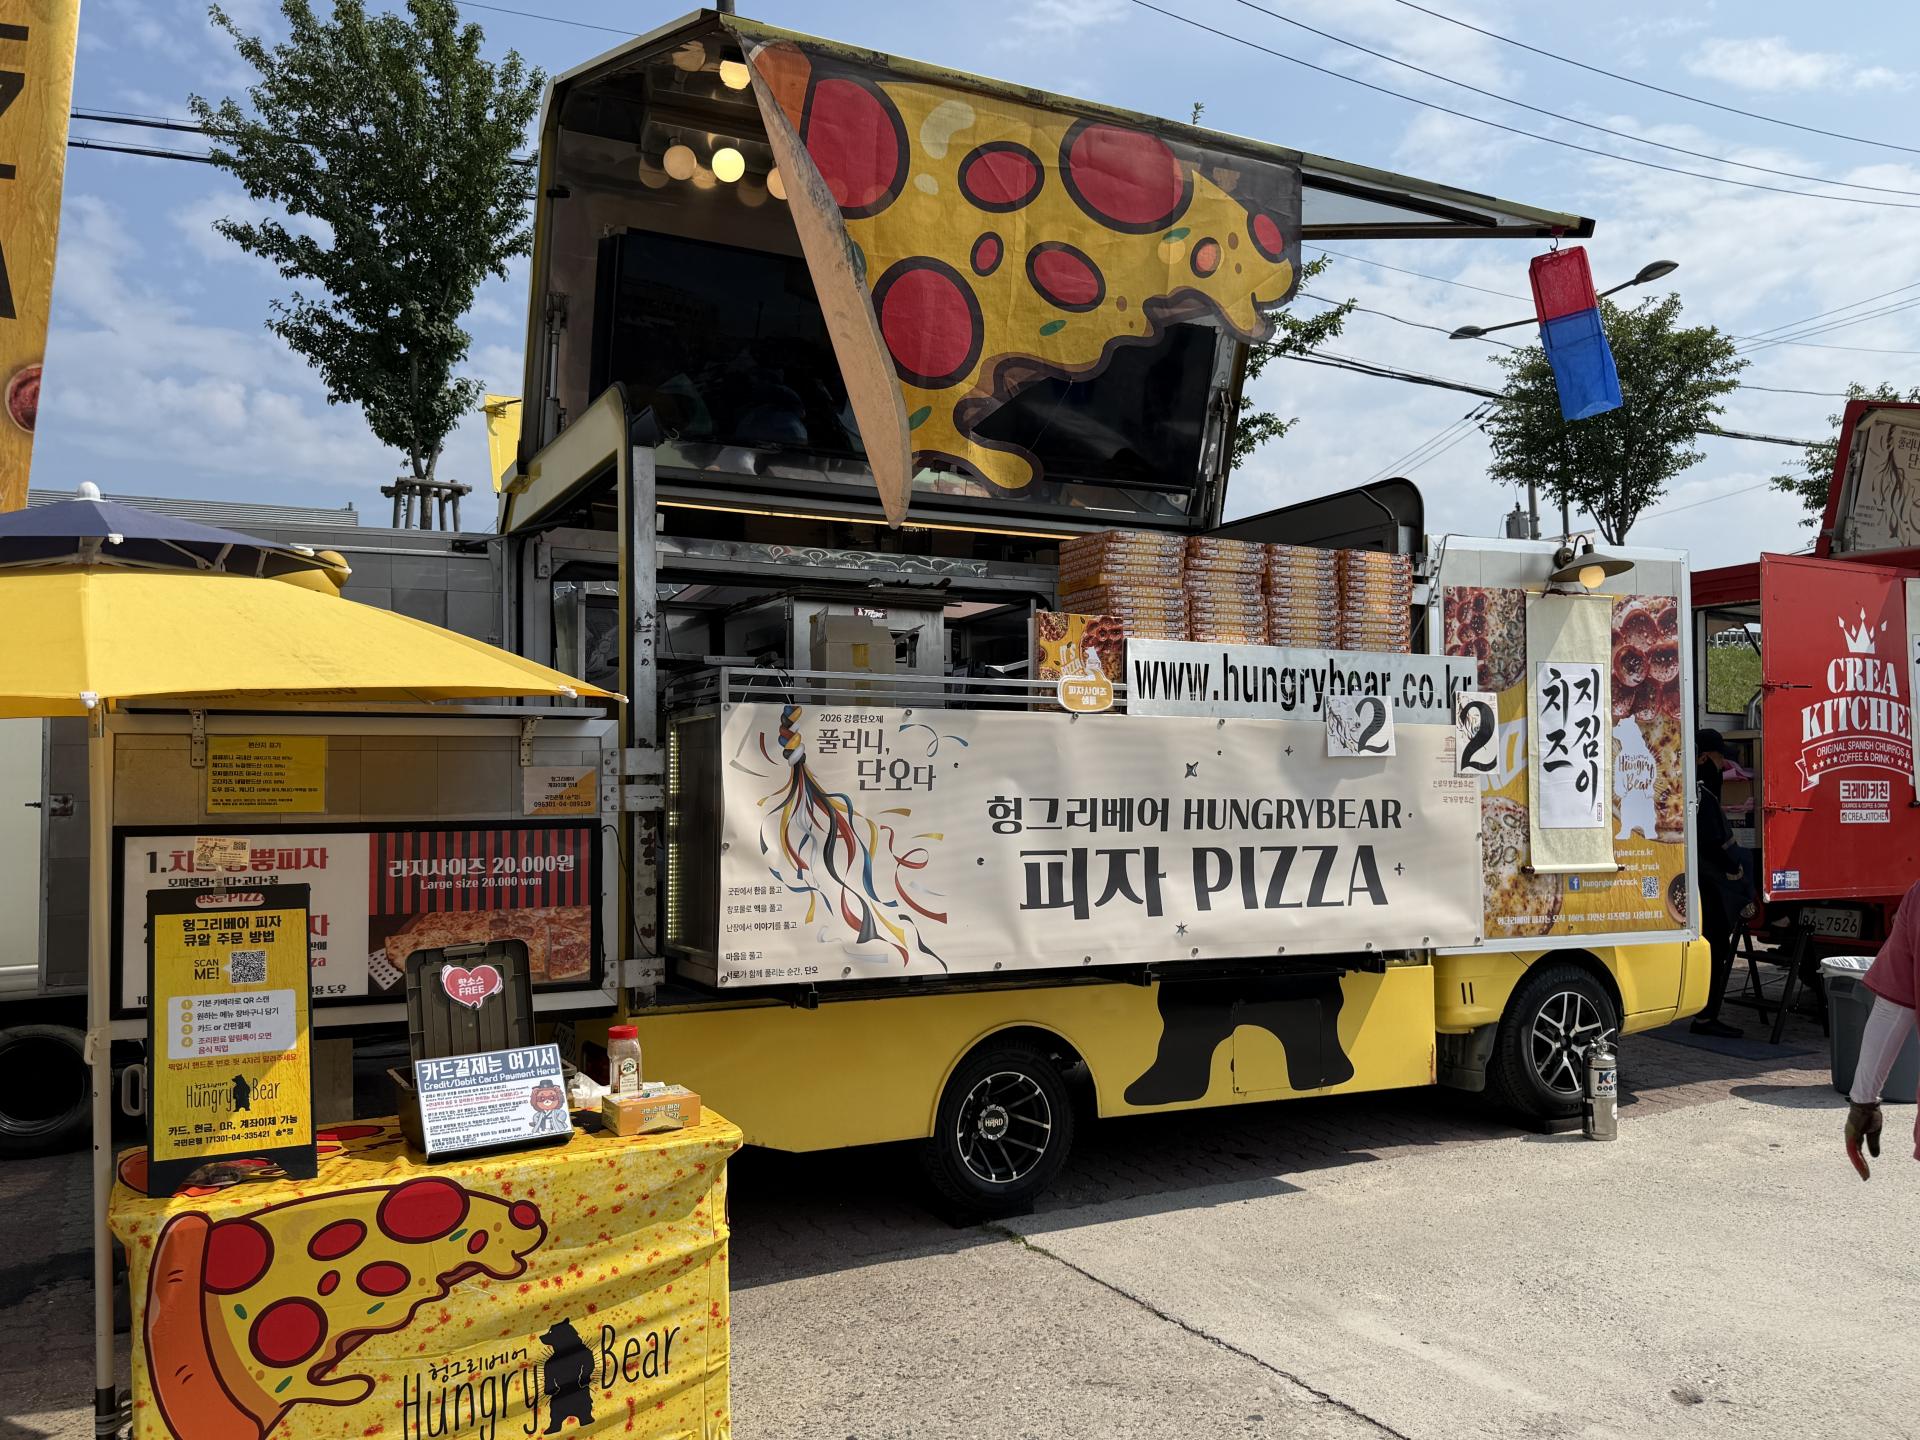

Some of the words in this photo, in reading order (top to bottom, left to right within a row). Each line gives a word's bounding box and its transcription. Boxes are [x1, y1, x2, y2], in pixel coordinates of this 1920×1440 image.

[1134, 652, 1472, 712] www.hungrybear.co.kr
[1826, 657, 1900, 698] CREA
[820, 714, 842, 723] 2026
[844, 714, 884, 724] 강릉단오제
[1355, 697, 1390, 754] 2
[1540, 668, 1574, 772] 치즈
[816, 728, 890, 755] 풀리니,
[1460, 700, 1498, 772] 2
[1572, 668, 1600, 815] 지짐이
[1816, 742, 1847, 757] ORIGINAL
[1848, 740, 1874, 750] SPANISH
[1875, 742, 1905, 756] CHURROS
[1839, 753, 1864, 764] COFFEE
[1864, 753, 1870, 761] &
[1870, 753, 1890, 764] DRINK
[857, 758, 936, 792] 단오다
[1618, 756, 1654, 779] Hungry
[1626, 773, 1652, 792] Bear
[1842, 783, 1888, 799] 크레아키친
[986, 795, 1170, 834] 헝그리베어
[1184, 798, 1402, 831] HUNGRYBEAR
[1614, 848, 1654, 858] rybear.co.kr
[388, 858, 486, 878] 라지사이즈
[492, 854, 575, 874] 20.000원
[420, 879, 452, 890] Large
[455, 878, 479, 889] size
[482, 876, 518, 887] 20.000
[521, 877, 542, 886] won
[1019, 846, 1166, 921] 피자
[1192, 844, 1389, 912] PIZZA
[182, 917, 250, 932] 헝그리베어
[256, 915, 282, 928] 피자
[754, 922, 781, 931] 이야기를
[184, 933, 211, 947] 큐알
[217, 932, 244, 945] 주문
[249, 930, 275, 944] 방법
[194, 959, 219, 968] SCAN
[726, 952, 747, 961] 마음을
[194, 967, 220, 980] ME!
[804, 966, 819, 975] 단오
[457, 976, 484, 987] 핫소스
[459, 985, 485, 996] FREE
[197, 1024, 212, 1033] 카드
[223, 1021, 251, 1030] 간편결제
[258, 1032, 272, 1040] 오면
[198, 1046, 213, 1055] 음식
[214, 1044, 229, 1053] 픽업
[421, 1056, 502, 1081] 카드결제는
[508, 1048, 555, 1070] 여기서
[423, 1077, 477, 1090] Credit/Debit
[478, 1074, 498, 1083] Card
[500, 1070, 535, 1082] Payment
[186, 1084, 232, 1114] Hungry
[252, 1077, 280, 1101] Bear
[240, 1116, 276, 1128] 계좌이체
[280, 1114, 298, 1125] 가능
[174, 1137, 203, 1147] 국민은행
[428, 1348, 528, 1384] 헝그리베어
[403, 1365, 538, 1440] Hungry
[600, 1324, 680, 1390] Bear
